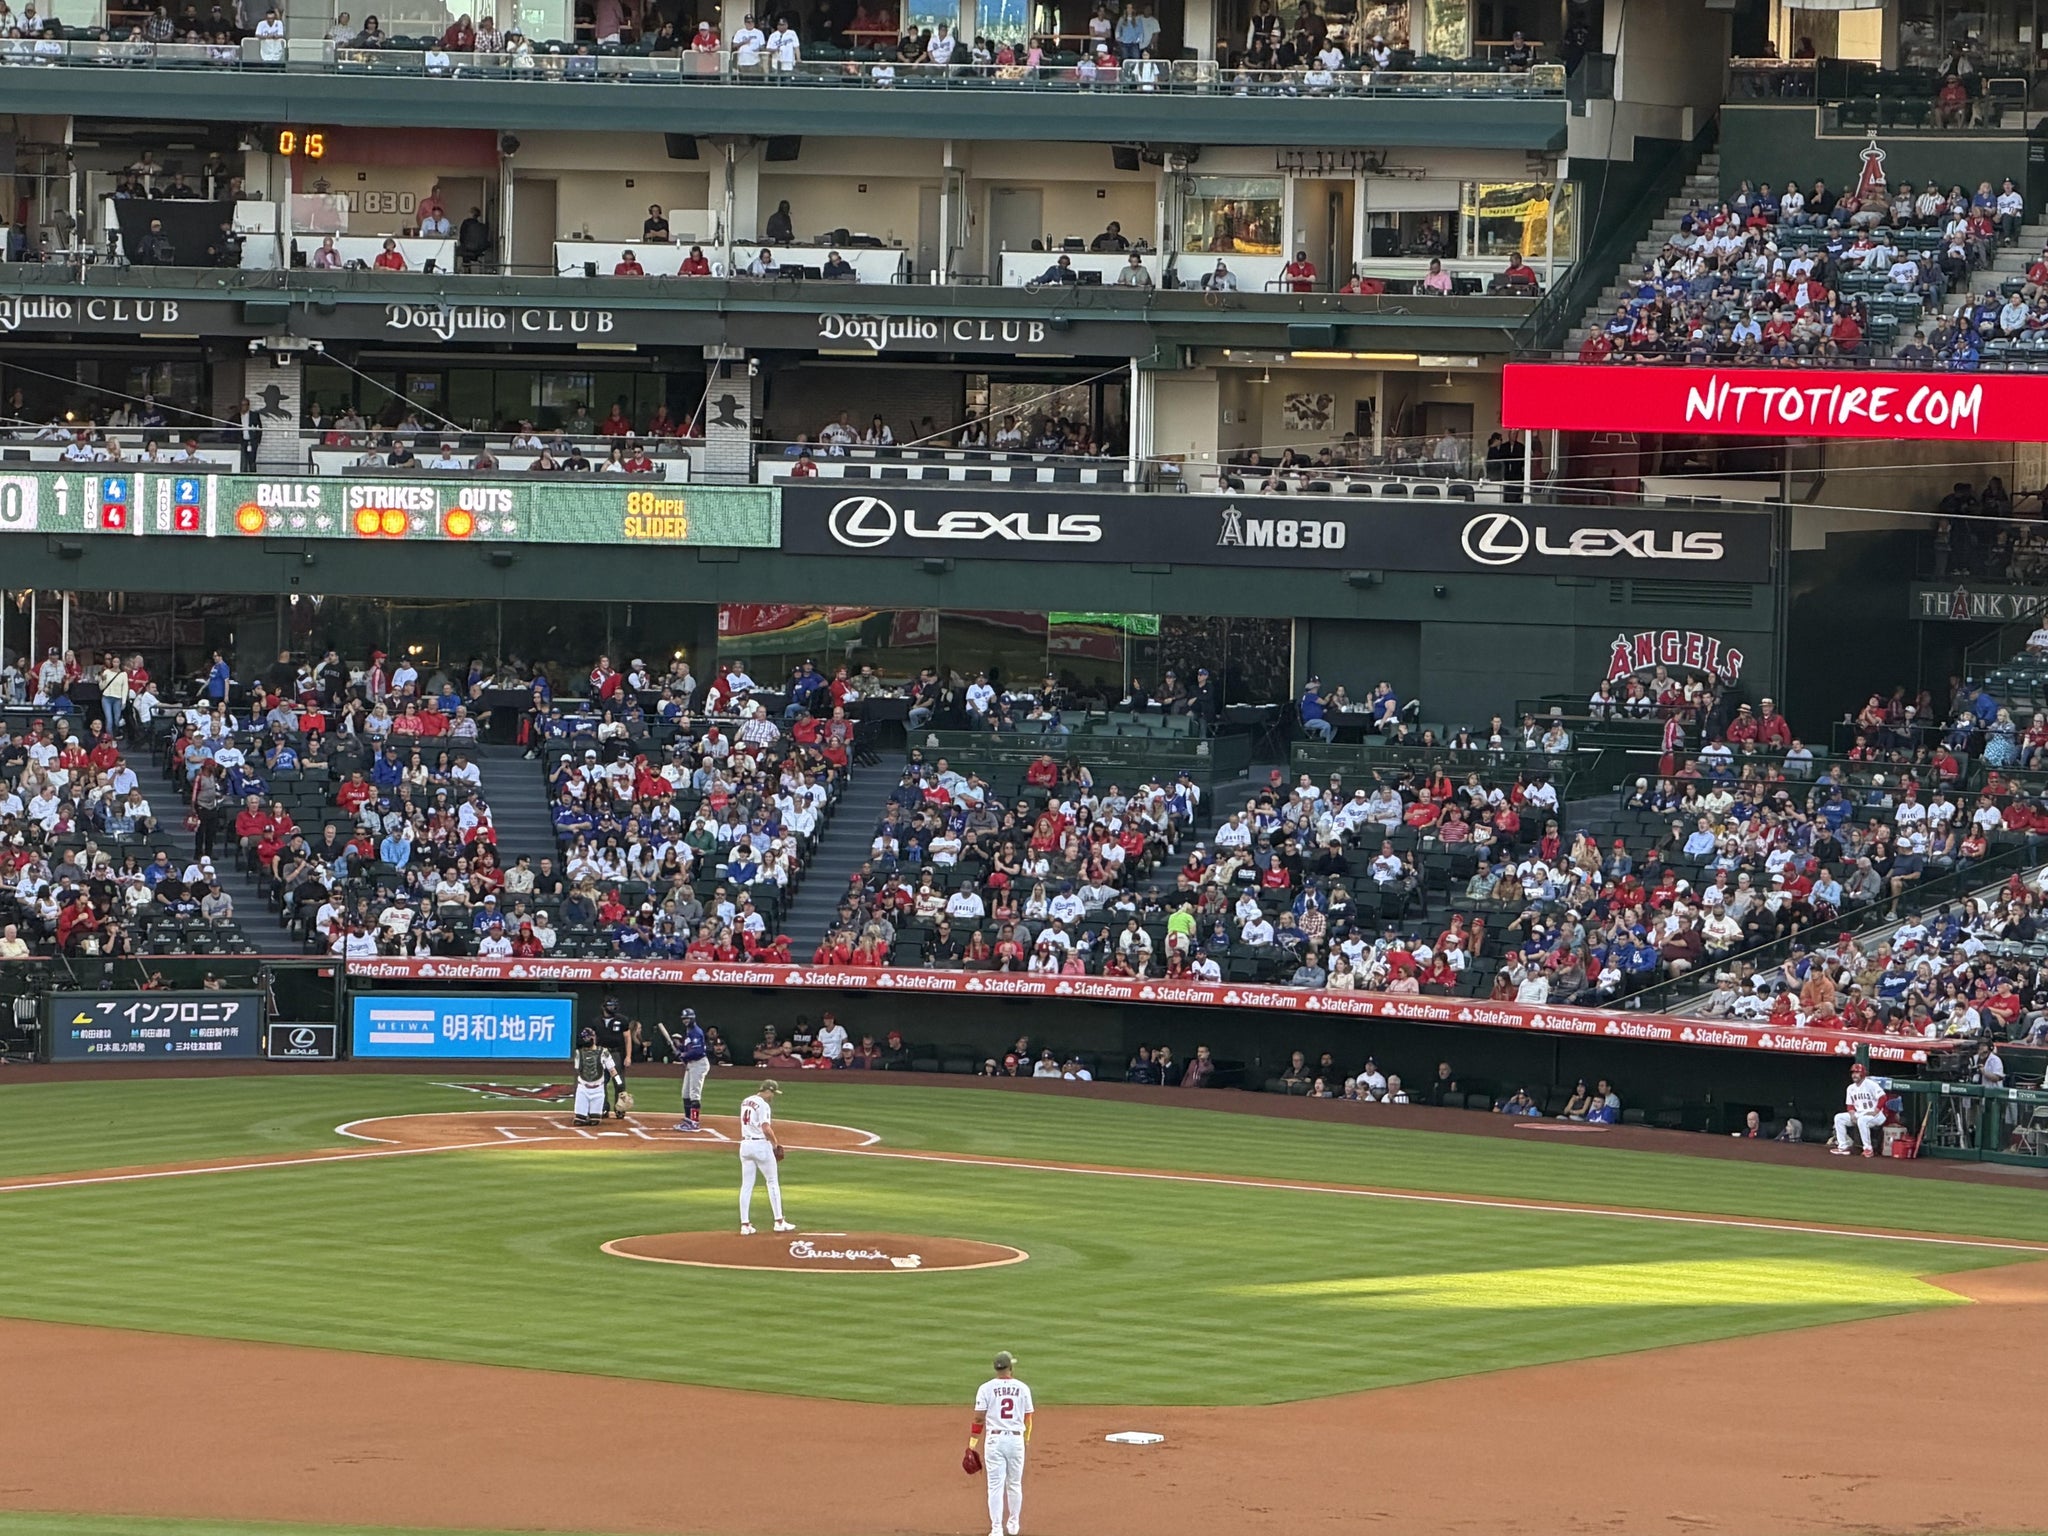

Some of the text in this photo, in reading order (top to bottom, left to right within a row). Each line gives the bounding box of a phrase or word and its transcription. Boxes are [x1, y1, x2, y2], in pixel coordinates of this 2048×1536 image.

[280, 131, 324, 159] 0:15
[364, 191, 416, 214] 830
[86, 299, 180, 322] CLUB
[521, 309, 614, 333] CLUB
[952, 319, 1045, 343] CLUB
[1685, 374, 1983, 435] NITTOTIRE.COM
[108, 480, 120, 499] 4
[181, 482, 194, 501] 2
[257, 484, 321, 508] BALLS
[350, 486, 434, 510] STRIKES
[459, 488, 513, 512] OUTS
[1, 482, 23, 522] 0
[86, 480, 95, 525] MVR
[160, 480, 169, 528] ABS
[108, 508, 120, 526] 4
[180, 509, 193, 528] 2
[624, 516, 689, 539] SLIDER
[904, 510, 1102, 542] LEXUS
[1535, 527, 1725, 560] LEXUS
[1920, 584, 2005, 620] THANK
[1607, 630, 1744, 687] ANGELS
[123, 1002, 240, 1024] インフロニア
[377, 1022, 429, 1031] MEIWA
[442, 1014, 555, 1042] 明和地所
[96, 1042, 146, 1052] 日本風力開発
[993, 1386, 1020, 1397] PERAZA
[1000, 1398, 1014, 1419] 2
